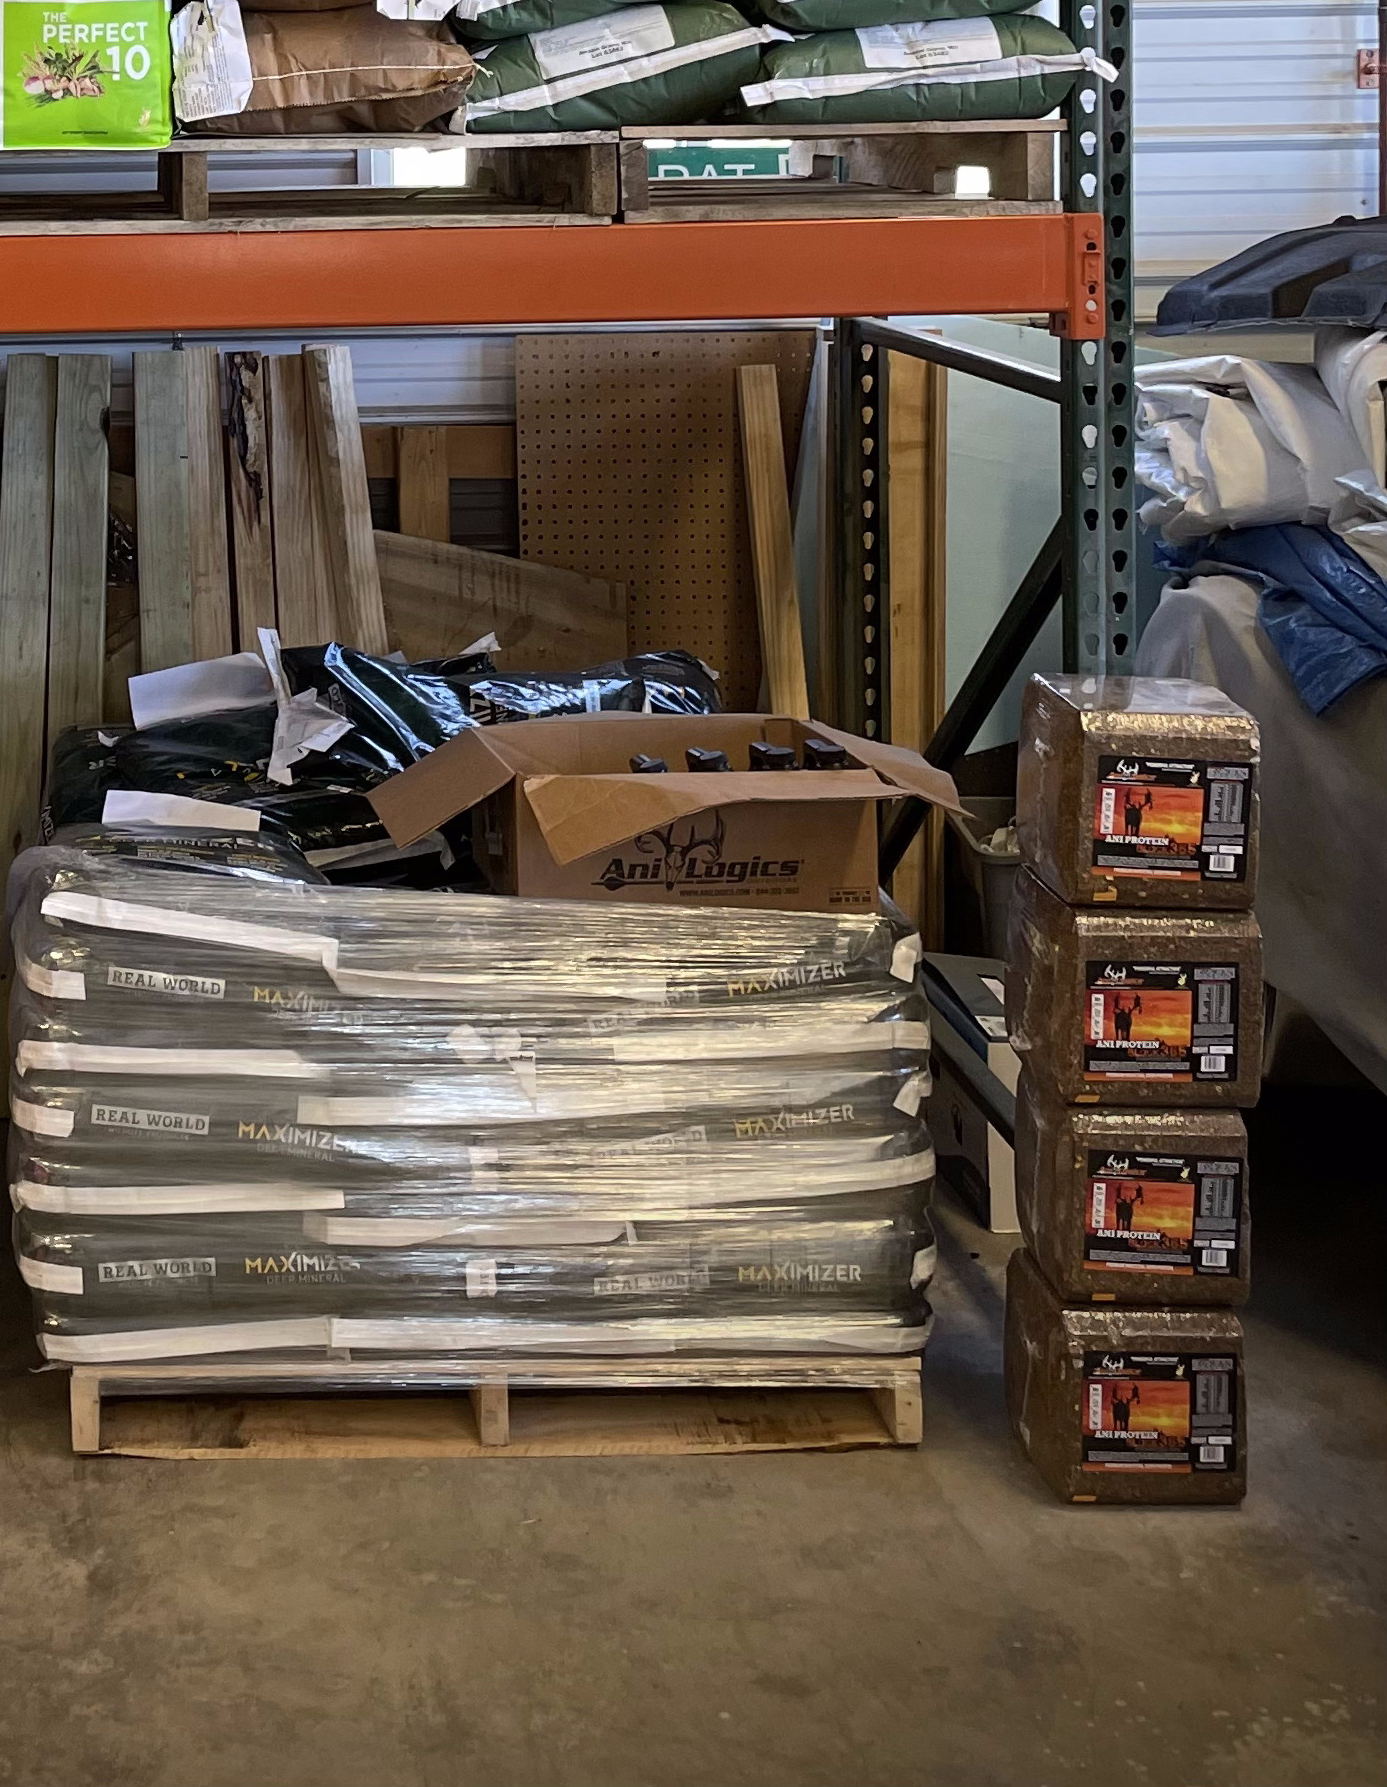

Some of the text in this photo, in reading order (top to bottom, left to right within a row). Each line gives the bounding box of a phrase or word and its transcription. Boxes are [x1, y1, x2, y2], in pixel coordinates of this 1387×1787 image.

[43, 12, 68, 23] THE
[42, 21, 149, 44] PERFECT
[106, 45, 151, 81] 10
[1124, 835, 1170, 846] PROTEIN
[600, 856, 801, 884] Ani Logics
[111, 969, 222, 996] REAL WORLD
[727, 961, 847, 997] MAXIMIZER
[1096, 1040, 1160, 1049] ANI PROTEIN
[95, 1107, 206, 1132] REAL WORLD
[734, 1104, 855, 1138] MAXIMIZER
[1116, 1230, 1161, 1240] PROTEIN
[102, 1259, 212, 1279] REAL WORLD
[738, 1261, 861, 1282] MAXIMIZER
[1113, 1430, 1159, 1440] PROTEIN
